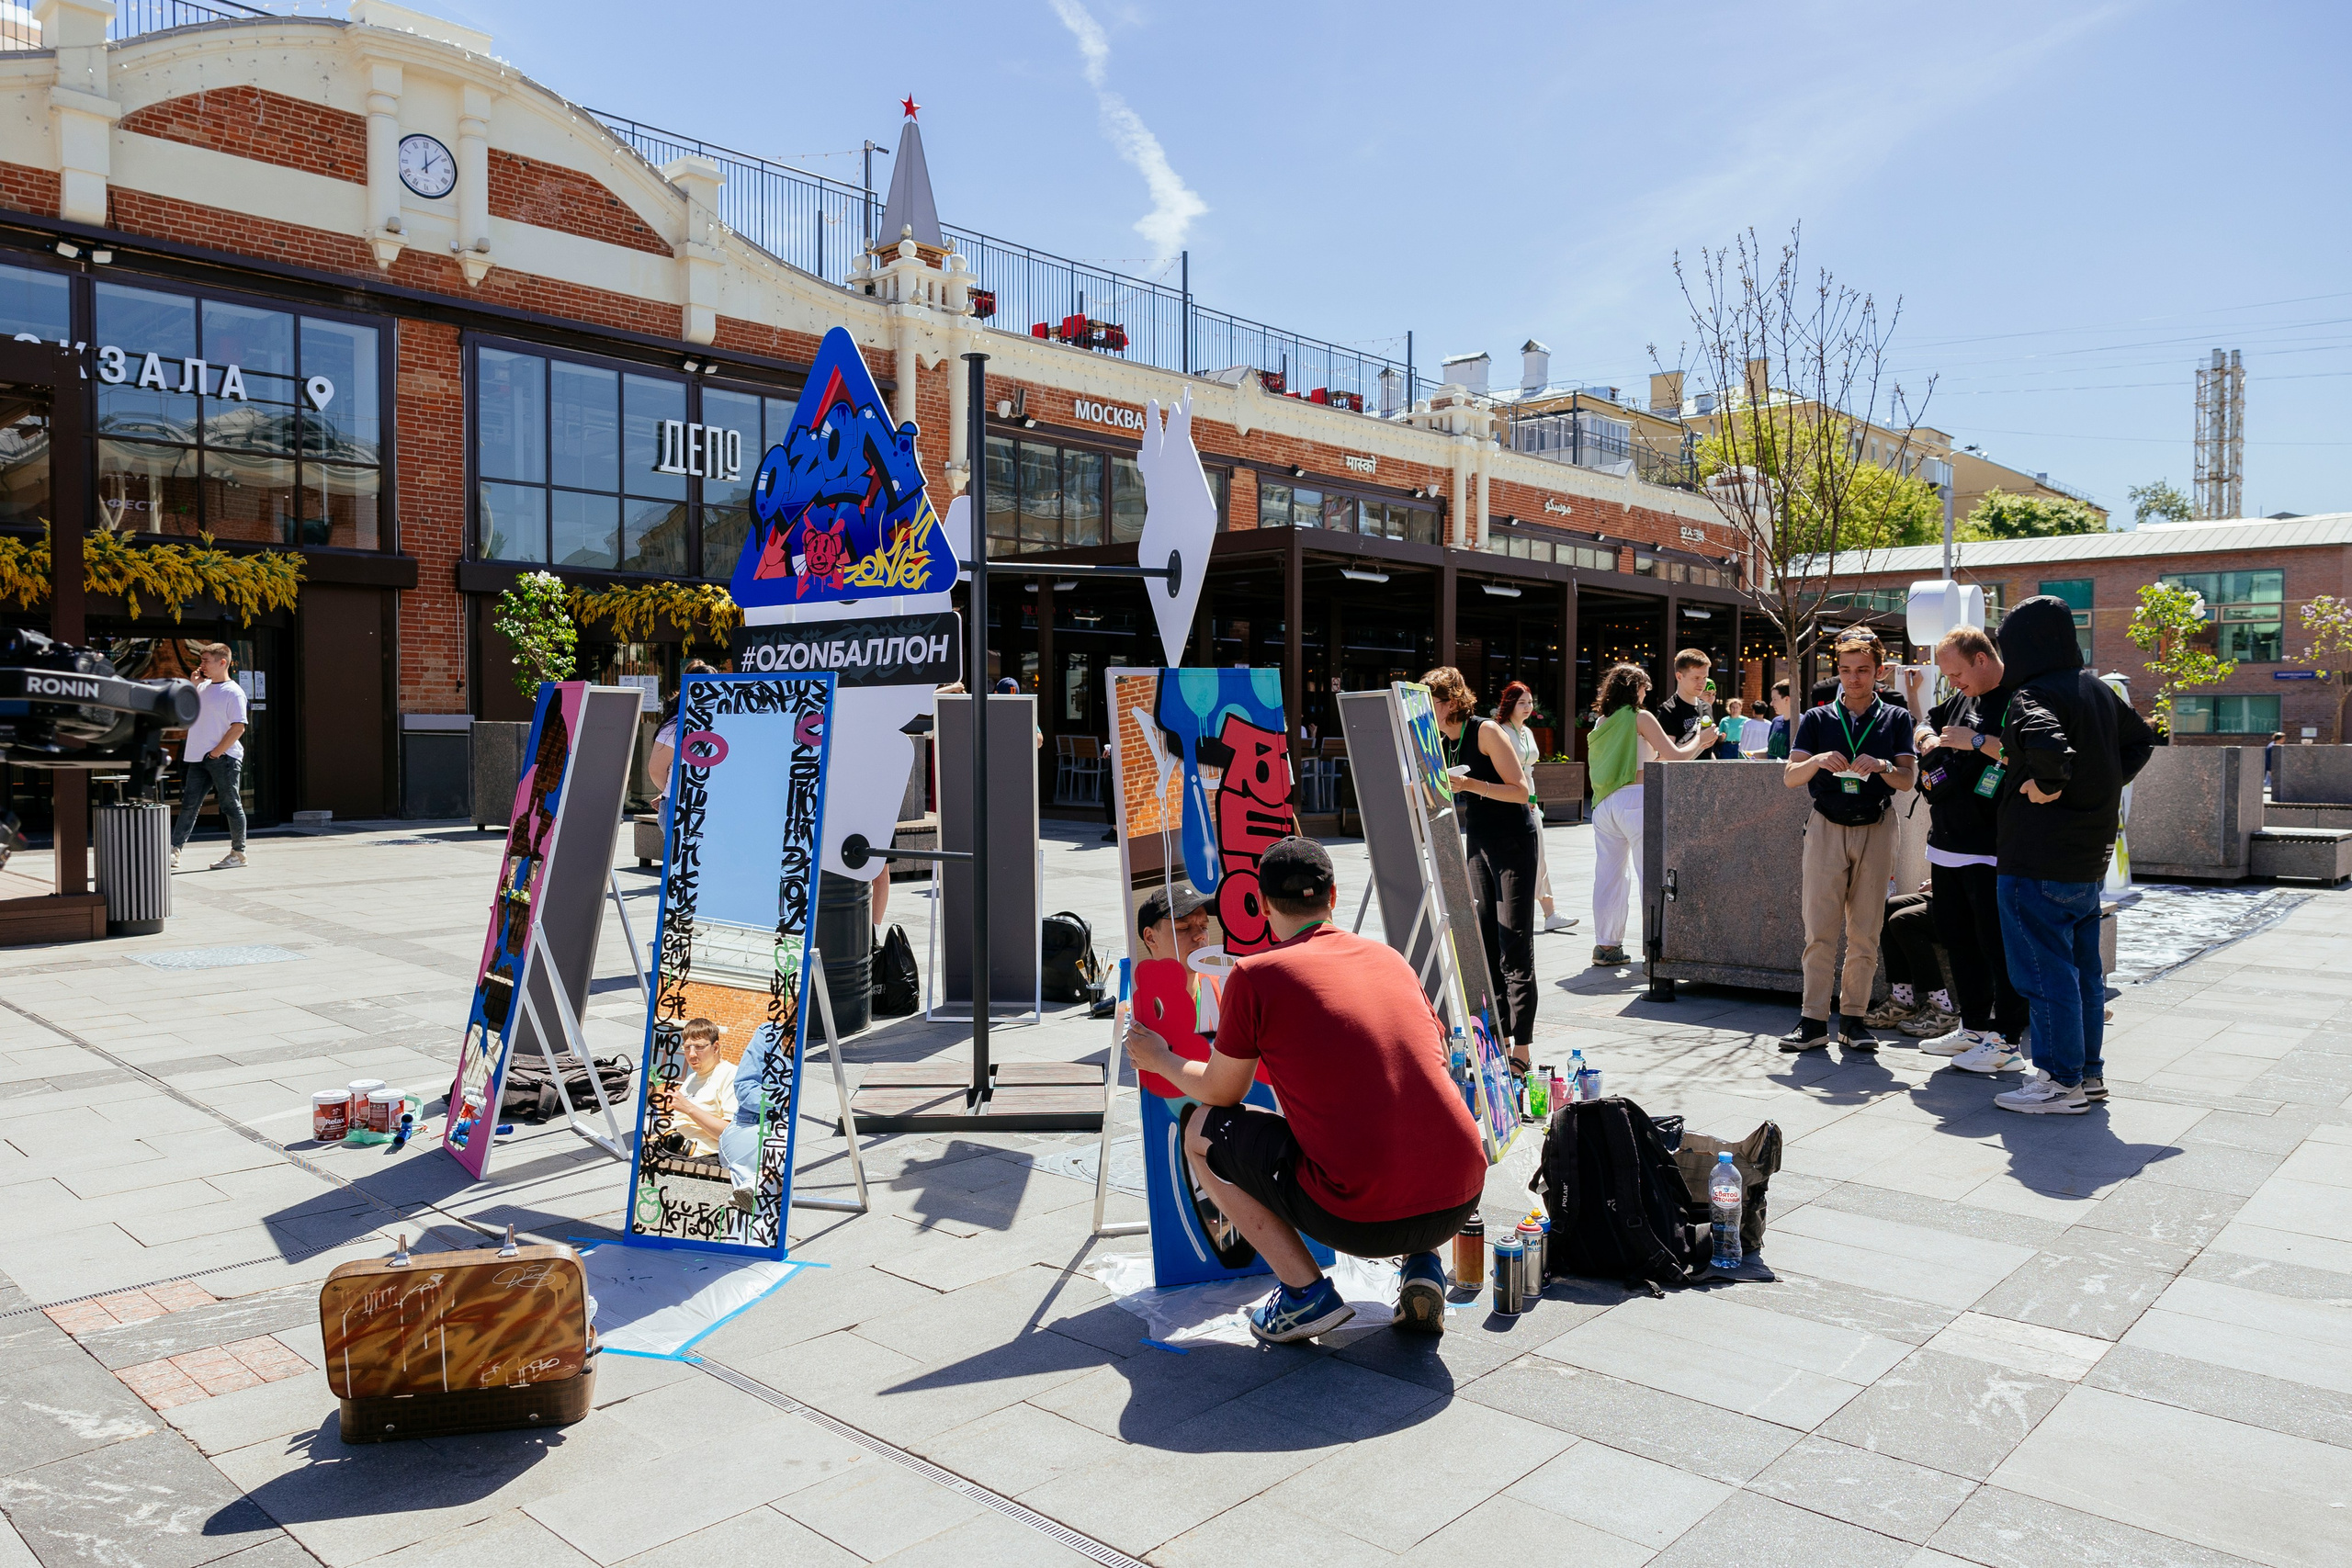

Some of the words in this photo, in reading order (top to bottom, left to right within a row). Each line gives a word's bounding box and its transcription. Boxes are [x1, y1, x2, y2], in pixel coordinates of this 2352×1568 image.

[14, 333, 248, 400] ЗАЛА
[1075, 399, 1146, 432] МОСКВА
[659, 419, 741, 481] ДЕПО
[1345, 455, 1377, 475] मास्को
[1544, 498, 1572, 516] موسكو
[741, 634, 950, 672] #OZONБАЛЛОН
[27, 675, 100, 699] RONIN
[325, 1117, 345, 1126] Relax
